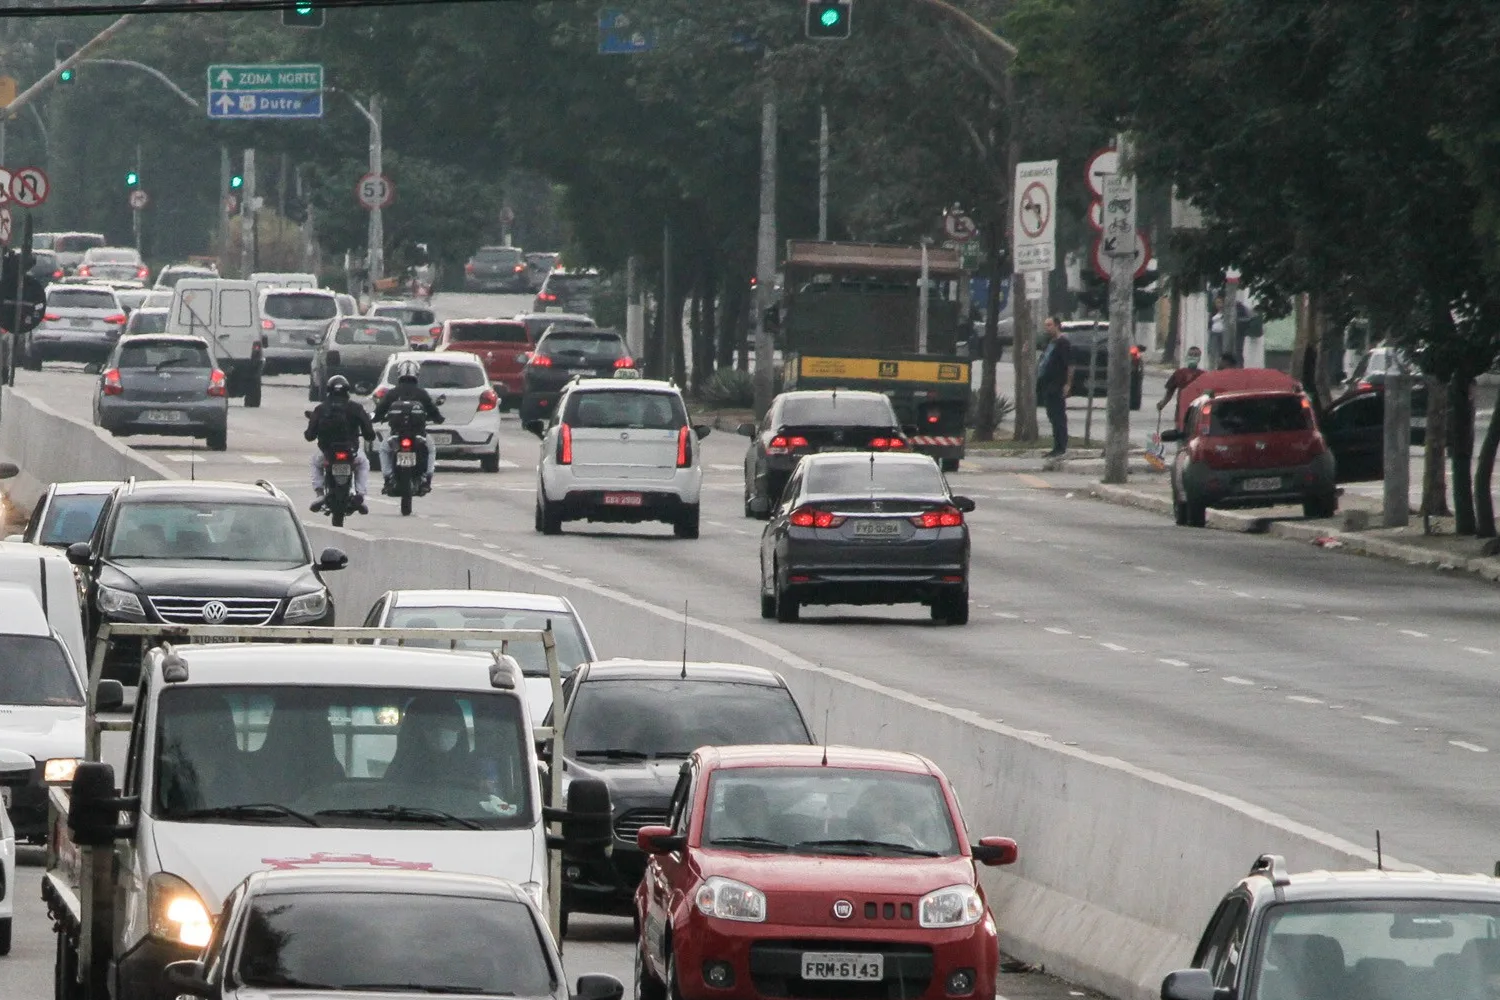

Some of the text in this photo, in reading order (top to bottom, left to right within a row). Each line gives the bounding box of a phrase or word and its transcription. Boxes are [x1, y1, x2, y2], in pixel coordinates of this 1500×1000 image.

[239, 73, 318, 85] ZONA NORTE
[260, 97, 302, 109] Dutra
